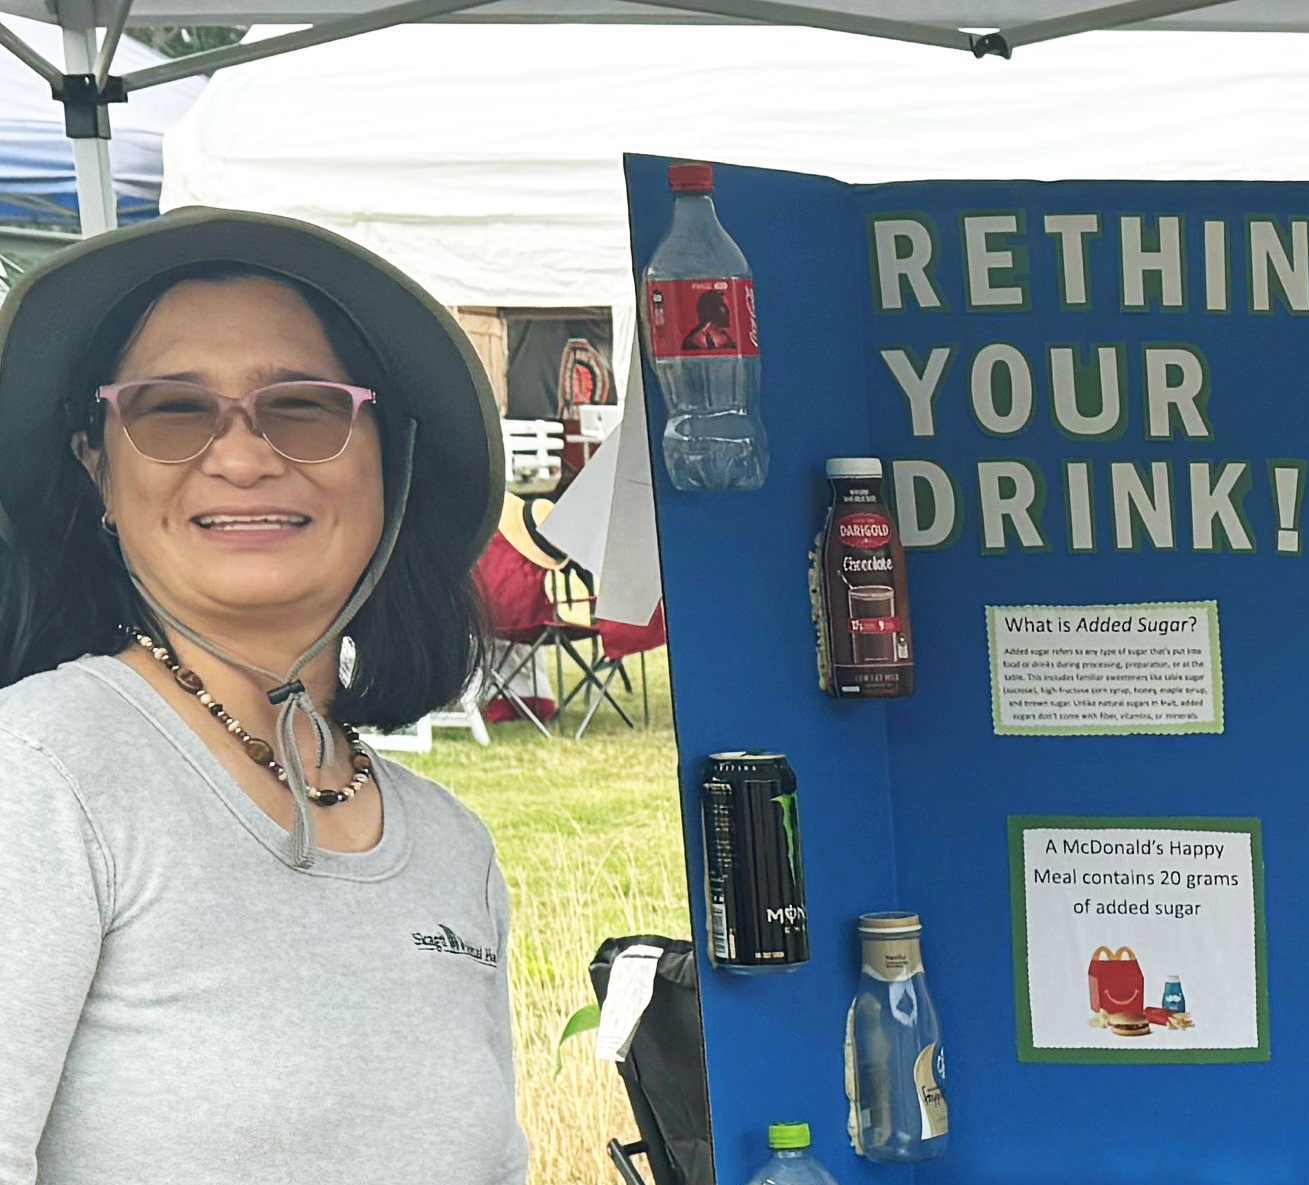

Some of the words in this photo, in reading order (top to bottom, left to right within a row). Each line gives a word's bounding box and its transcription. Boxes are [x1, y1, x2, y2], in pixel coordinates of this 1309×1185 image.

[881, 343, 1209, 438] YOUR
[893, 460, 1300, 552] DRINK!
[840, 524, 889, 537] DARIGOLD
[843, 556, 893, 572] Chocolate
[1005, 617, 1053, 633] What
[1058, 617, 1071, 632] is
[1076, 617, 1132, 632] Added
[1137, 616, 1197, 635] Sugar?
[1045, 840, 1057, 854] A
[1063, 839, 1164, 855] McDonald's
[1170, 840, 1225, 859] Happy
[1034, 869, 1077, 885] Meal
[1083, 869, 1155, 886] contains
[1161, 871, 1181, 886] 20
[1186, 873, 1239, 889] grams
[1073, 899, 1091, 914] of
[1097, 899, 1150, 915] added
[1155, 903, 1201, 918] sugar
